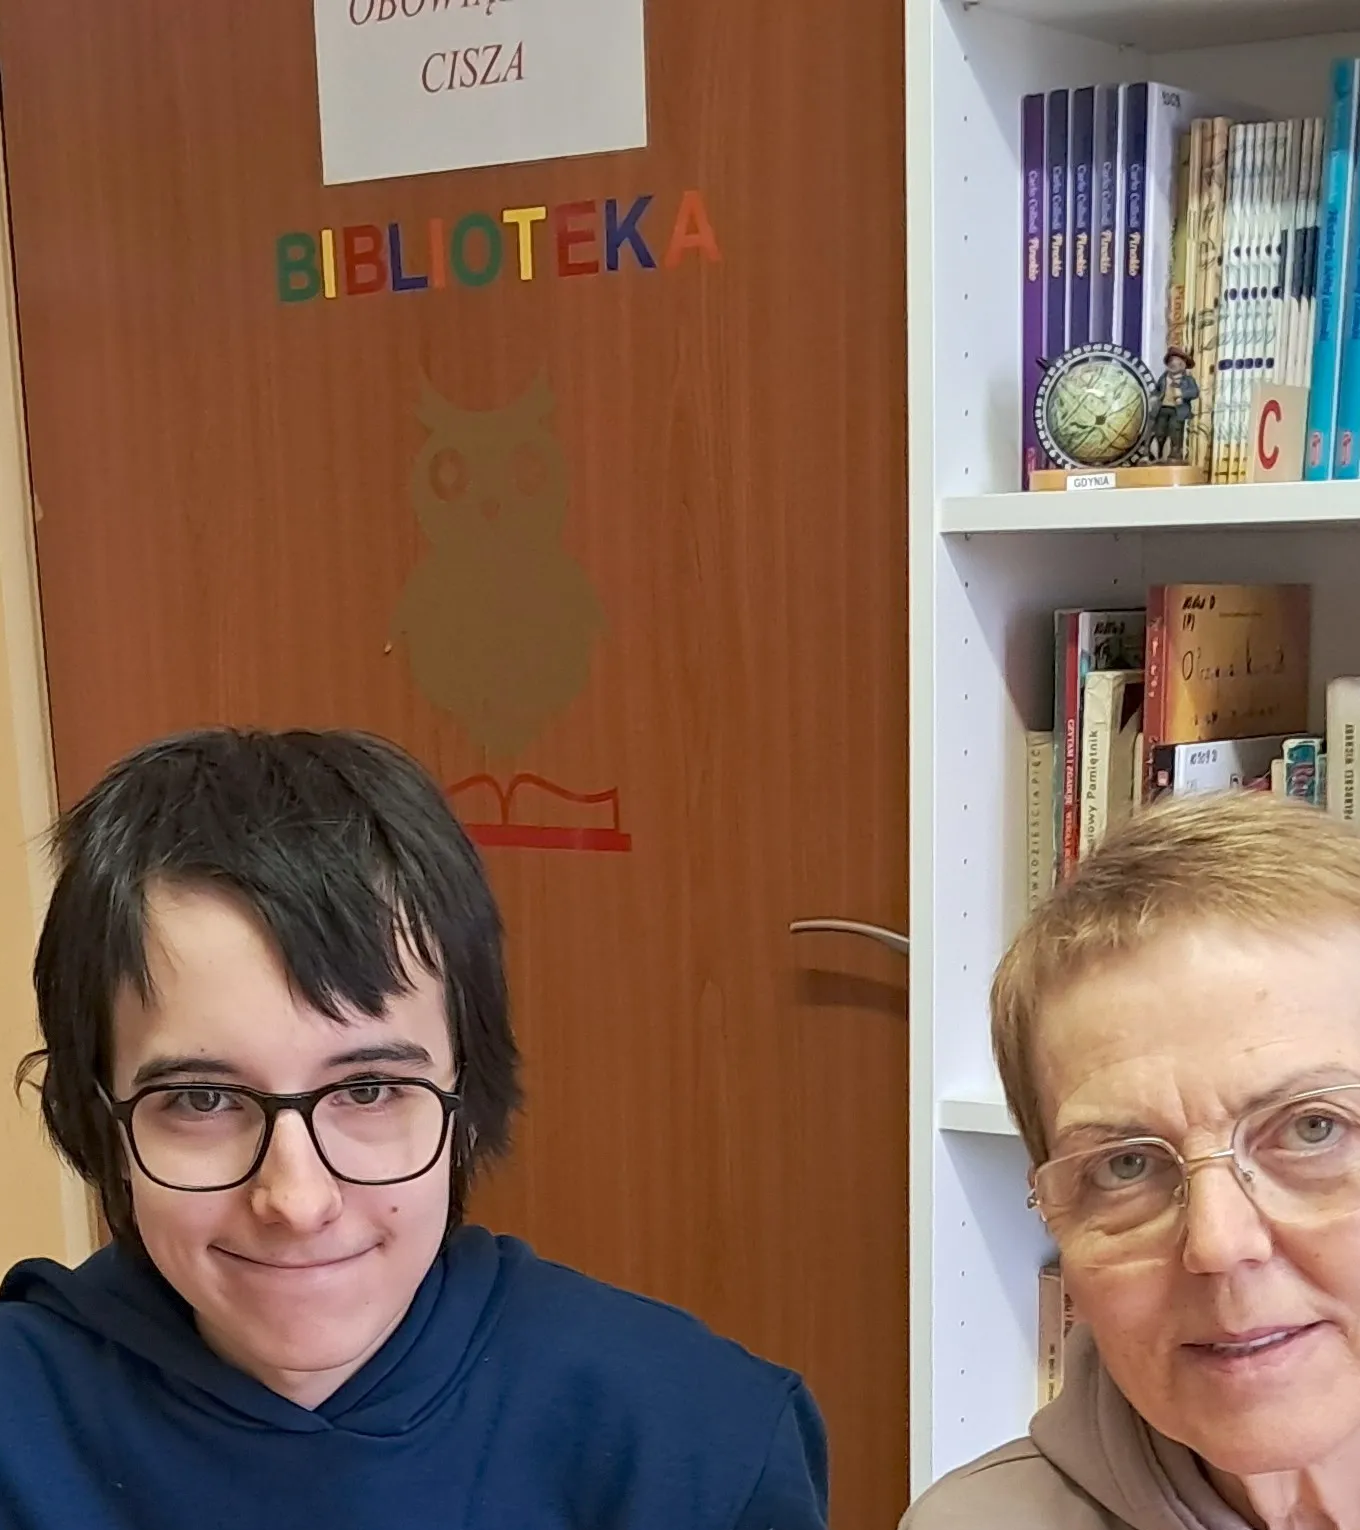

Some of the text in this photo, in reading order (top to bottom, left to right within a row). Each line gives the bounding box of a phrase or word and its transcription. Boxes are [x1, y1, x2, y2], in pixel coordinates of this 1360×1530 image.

[421, 41, 526, 93] CISZA
[276, 190, 722, 302] BIBLIOTEKA
[1028, 236, 1039, 280] Pinokio
[1050, 232, 1063, 276] Pinokio
[1258, 400, 1282, 470] C
[1073, 475, 1110, 488] GDYNIA
[1086, 731, 1098, 799] Pamiętnik
